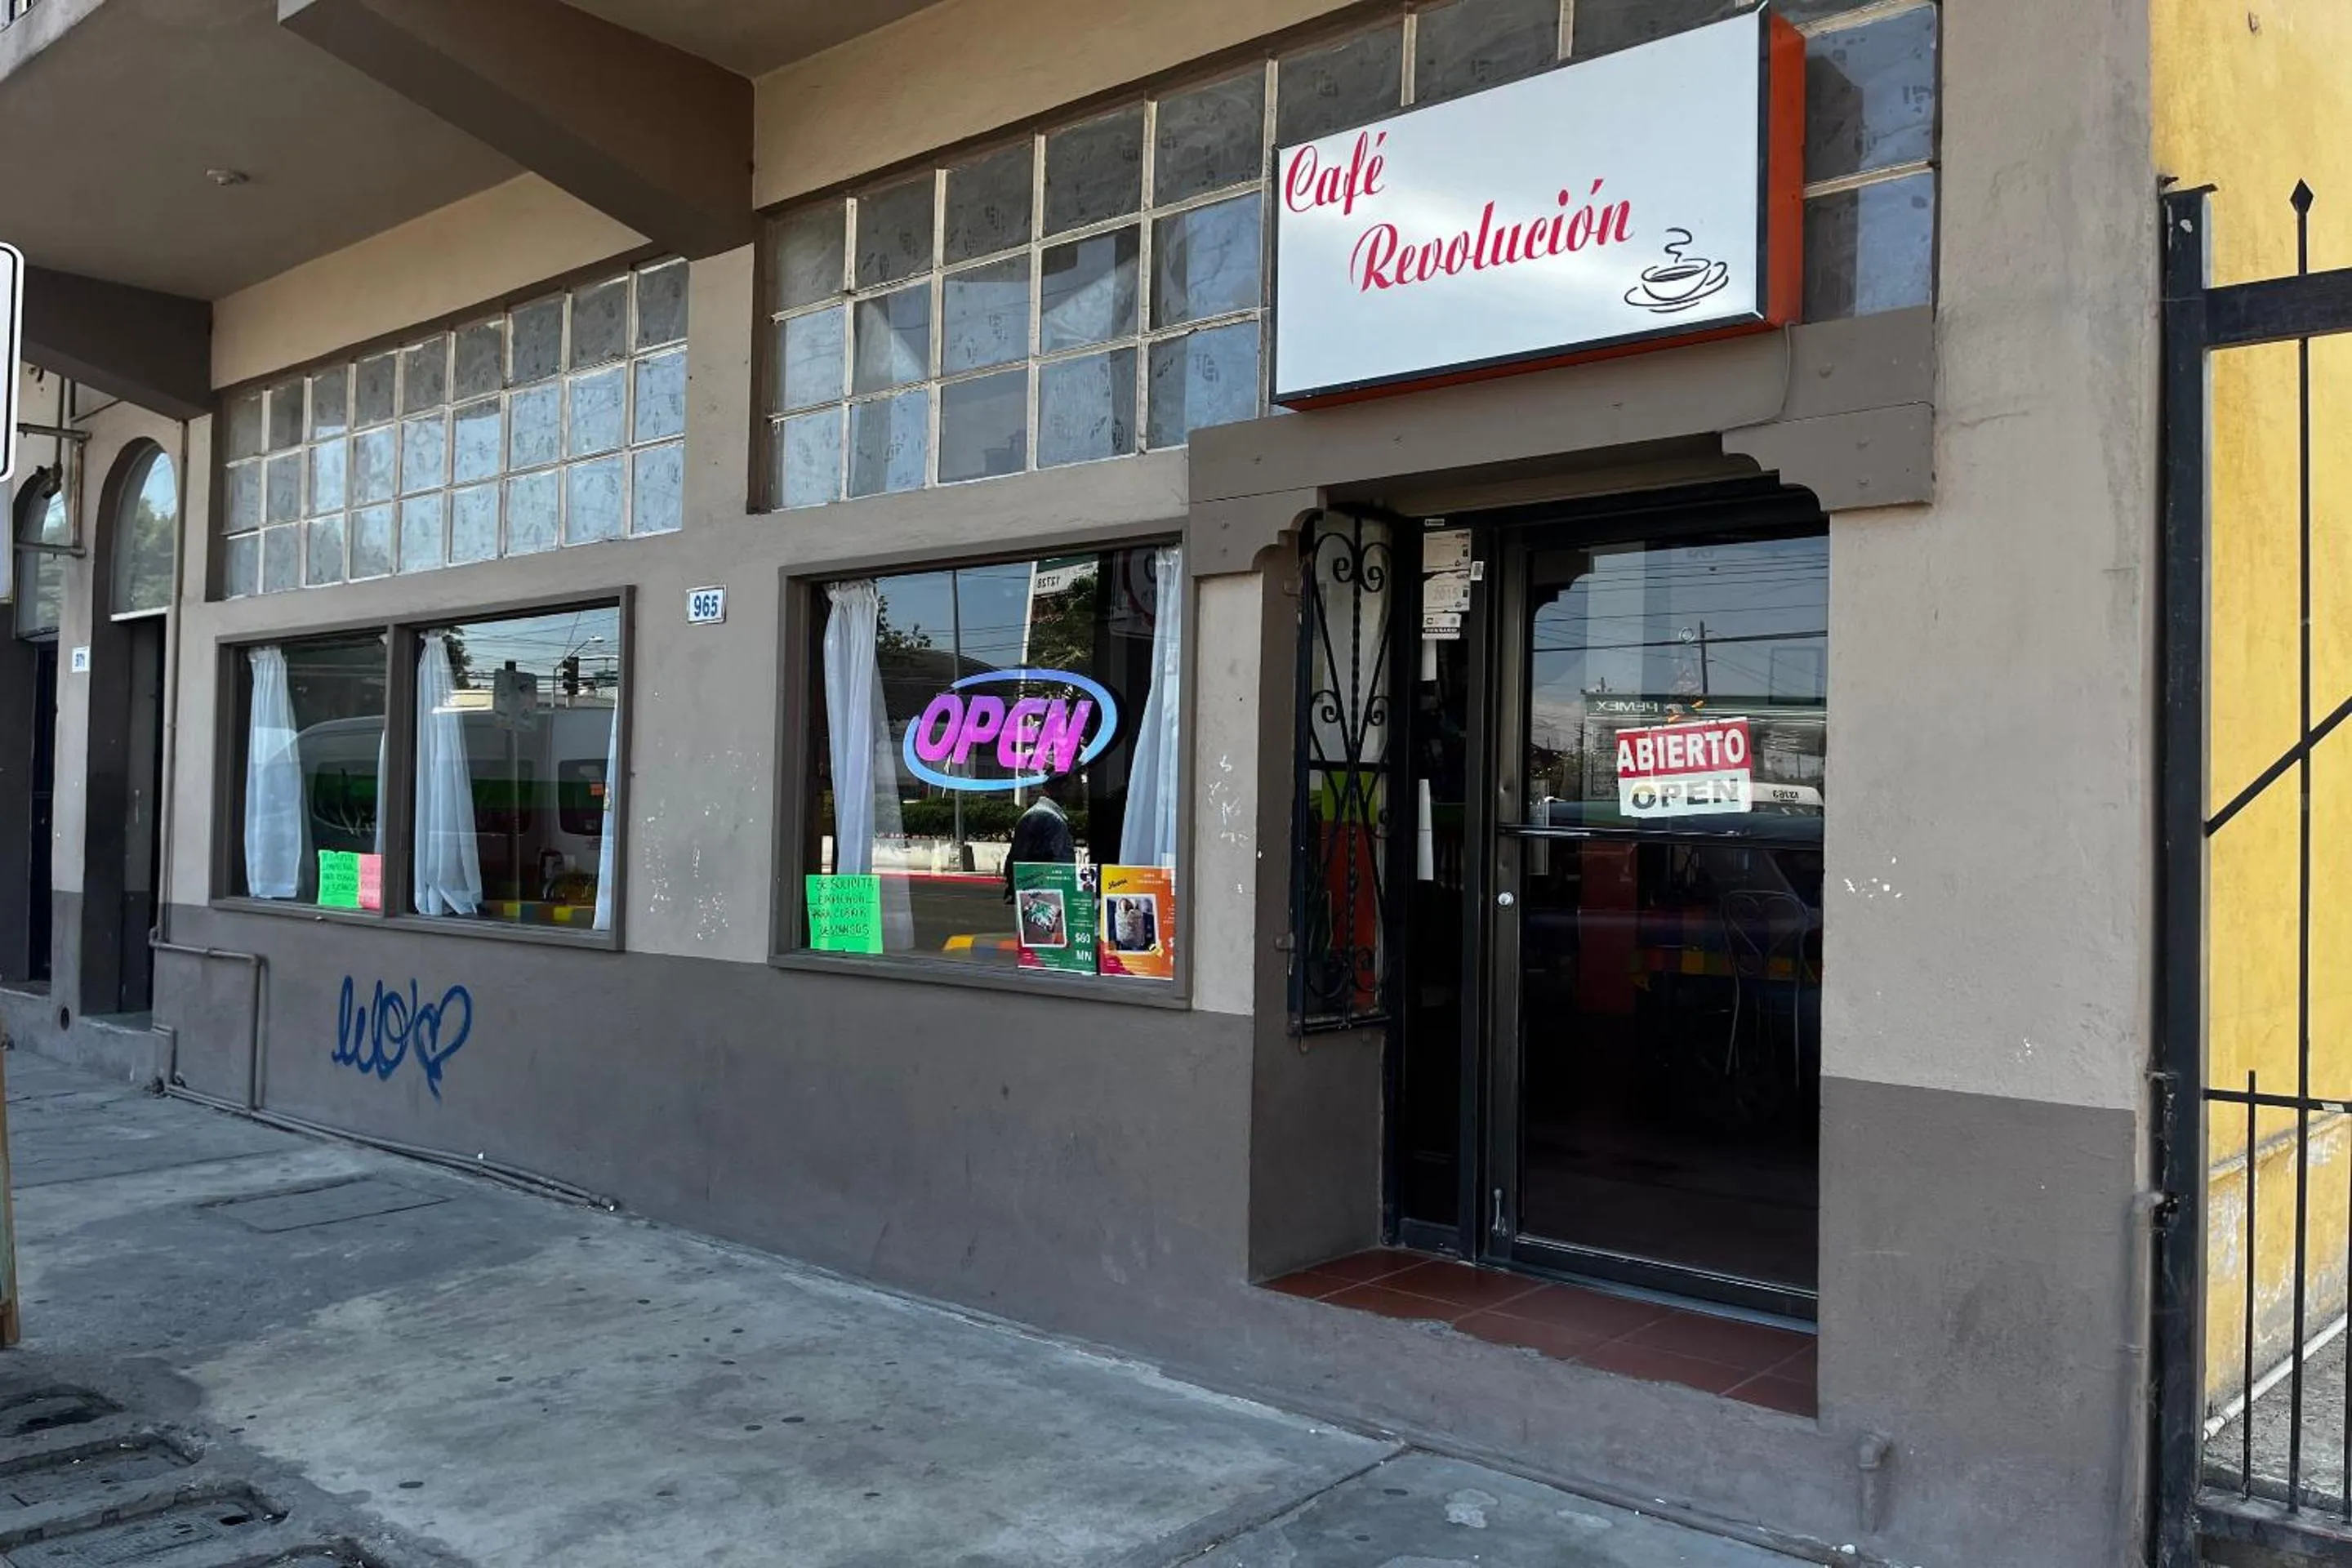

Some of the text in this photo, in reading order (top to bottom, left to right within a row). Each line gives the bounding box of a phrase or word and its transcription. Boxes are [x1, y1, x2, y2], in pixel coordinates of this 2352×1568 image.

[1285, 131, 1388, 216] Café
[1349, 178, 1635, 293] Revolución
[693, 594, 719, 617] 965
[915, 693, 1094, 773] OPEN
[1616, 728, 1747, 773] ABIERTO
[1632, 777, 1741, 810] OPEN
[1076, 950, 1093, 962] MN
